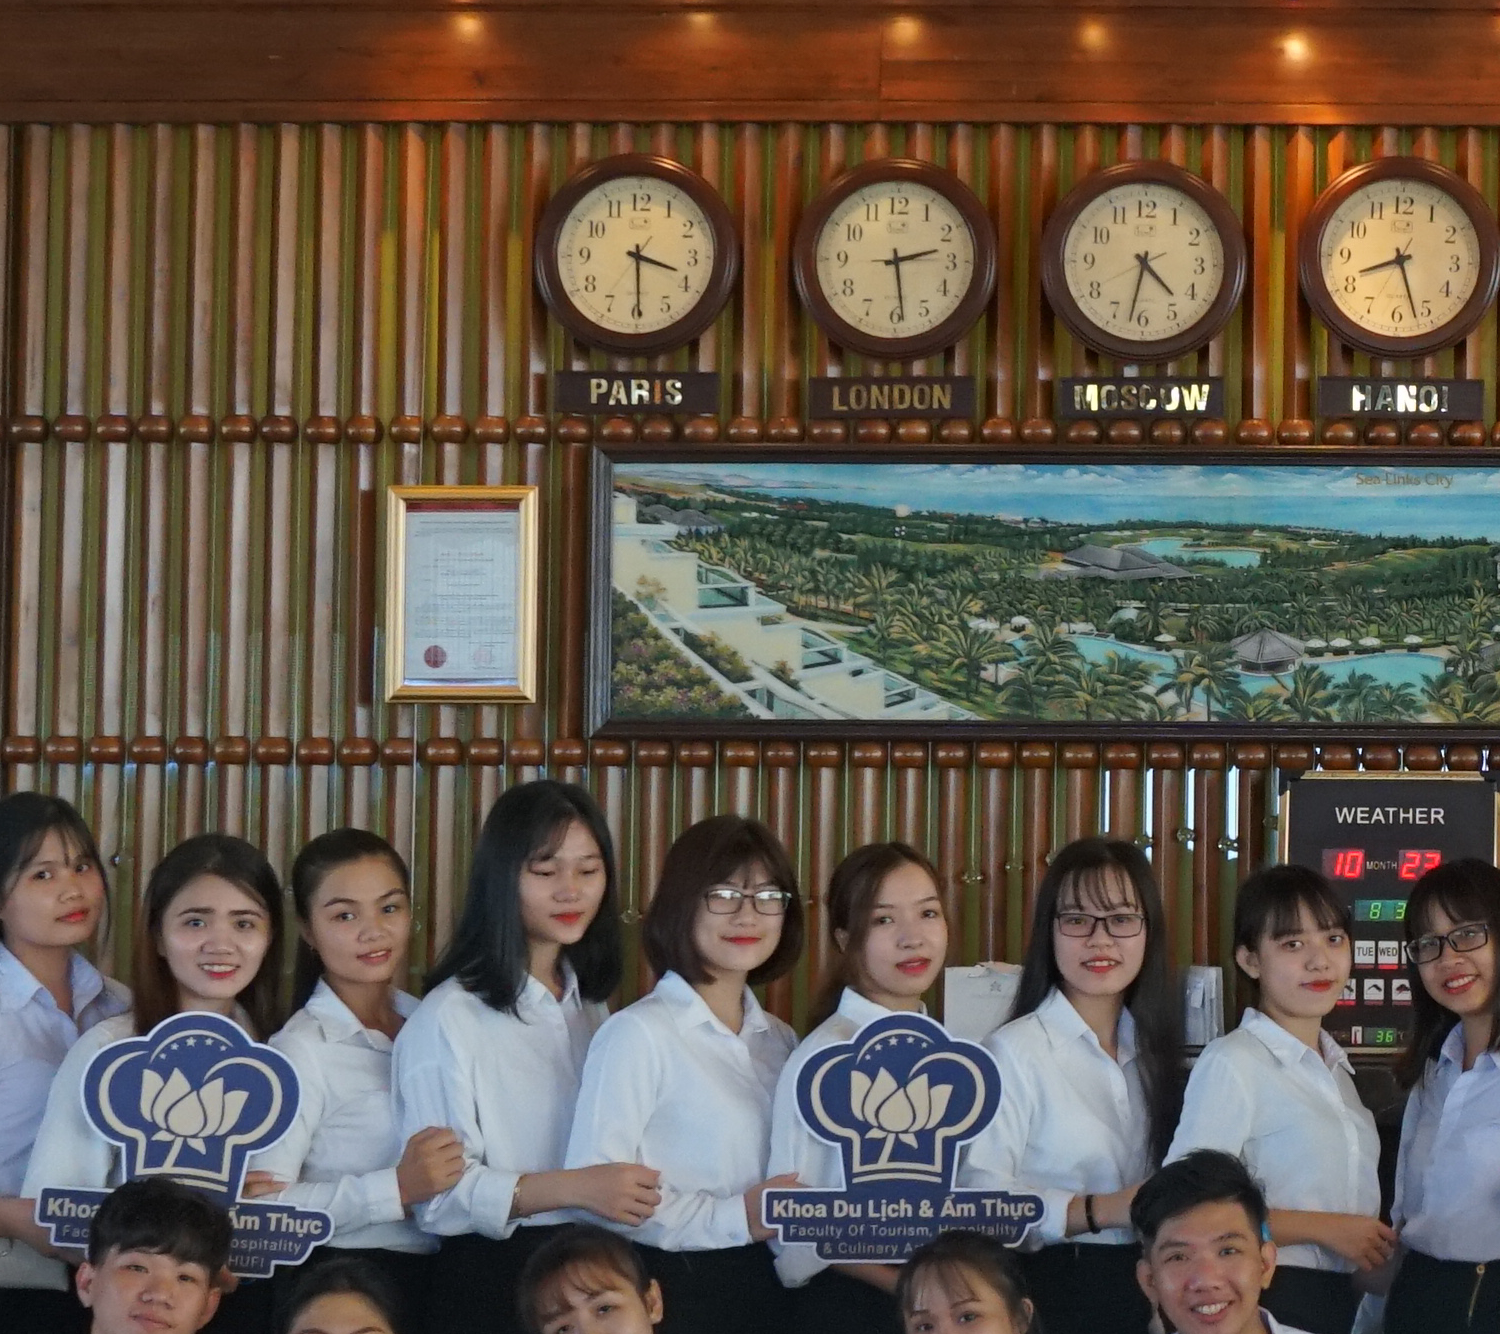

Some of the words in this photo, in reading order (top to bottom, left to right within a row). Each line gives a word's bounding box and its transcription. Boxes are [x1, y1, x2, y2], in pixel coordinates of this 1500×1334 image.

[631, 193, 651, 212] 12
[889, 197, 909, 215] 12
[1136, 200, 1156, 219] 12
[1369, 201, 1383, 219] 11
[1394, 196, 1414, 215] 12
[588, 220, 605, 238] 10
[1349, 221, 1366, 239] 10
[1445, 225, 1457, 243] 2
[836, 251, 848, 269] 9
[945, 252, 957, 271] 3
[1340, 247, 1352, 265] 9
[1448, 254, 1460, 273] 3
[1344, 275, 1356, 293] 8
[1439, 279, 1452, 297] 4
[1365, 296, 1375, 315] 7
[1391, 306, 1403, 323] 6
[1420, 299, 1432, 317] 5
[1137, 310, 1149, 327] 6
[590, 378, 683, 405] PARIS
[832, 384, 952, 411] LONDON
[1074, 384, 1209, 412] MOSCOW
[1351, 387, 1449, 414] HANOI
[1335, 807, 1445, 824] WEATHER
[1334, 850, 1365, 878] 10
[1366, 861, 1397, 870] MONTH
[1356, 946, 1374, 957] TUE
[1378, 946, 1398, 957] WED
[1376, 1030, 1394, 1044] 36
[773, 1198, 827, 1218] Khoa
[833, 1199, 862, 1218] Du
[868, 1198, 913, 1222] Lịch
[919, 1199, 934, 1218] &
[981, 1198, 1037, 1221] Thực
[266, 1213, 323, 1238] Thực
[789, 1224, 844, 1239] Faculty
[848, 1224, 866, 1237] Of
[871, 1224, 933, 1238] Tourism,
[231, 1238, 302, 1253] ospitality
[823, 1243, 832, 1254] &
[838, 1242, 898, 1256] Culinary
